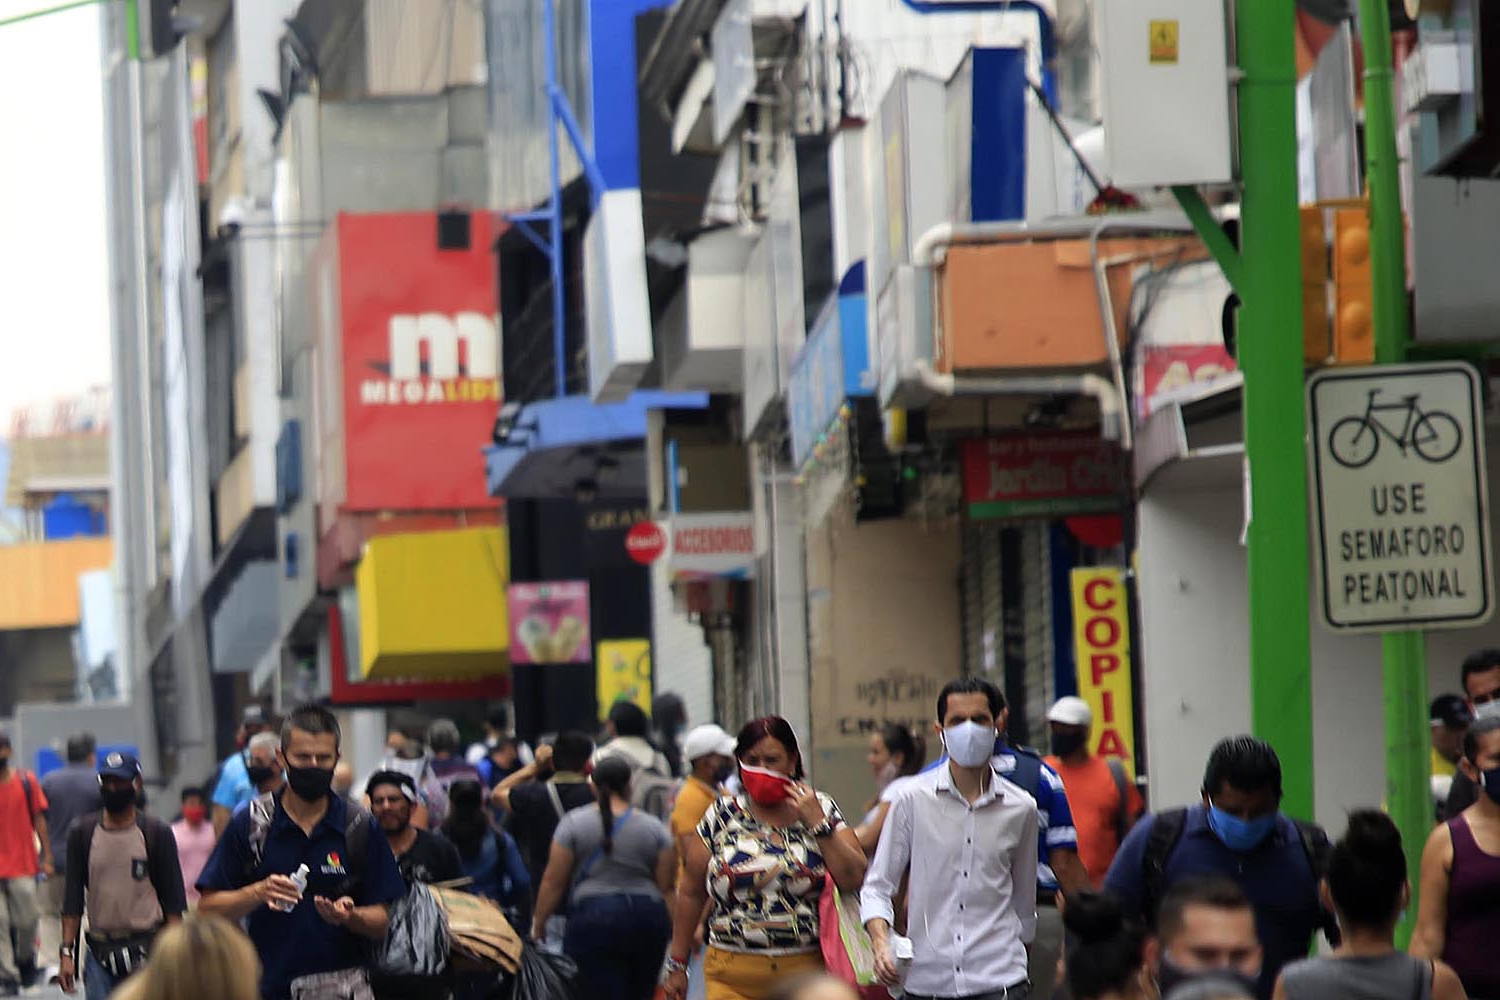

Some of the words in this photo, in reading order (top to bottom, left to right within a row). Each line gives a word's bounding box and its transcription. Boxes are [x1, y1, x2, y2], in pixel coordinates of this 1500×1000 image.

[1372, 483, 1426, 515] USE
[1340, 524, 1465, 561] SEMAFORO
[1344, 568, 1467, 604] PEATONAL
